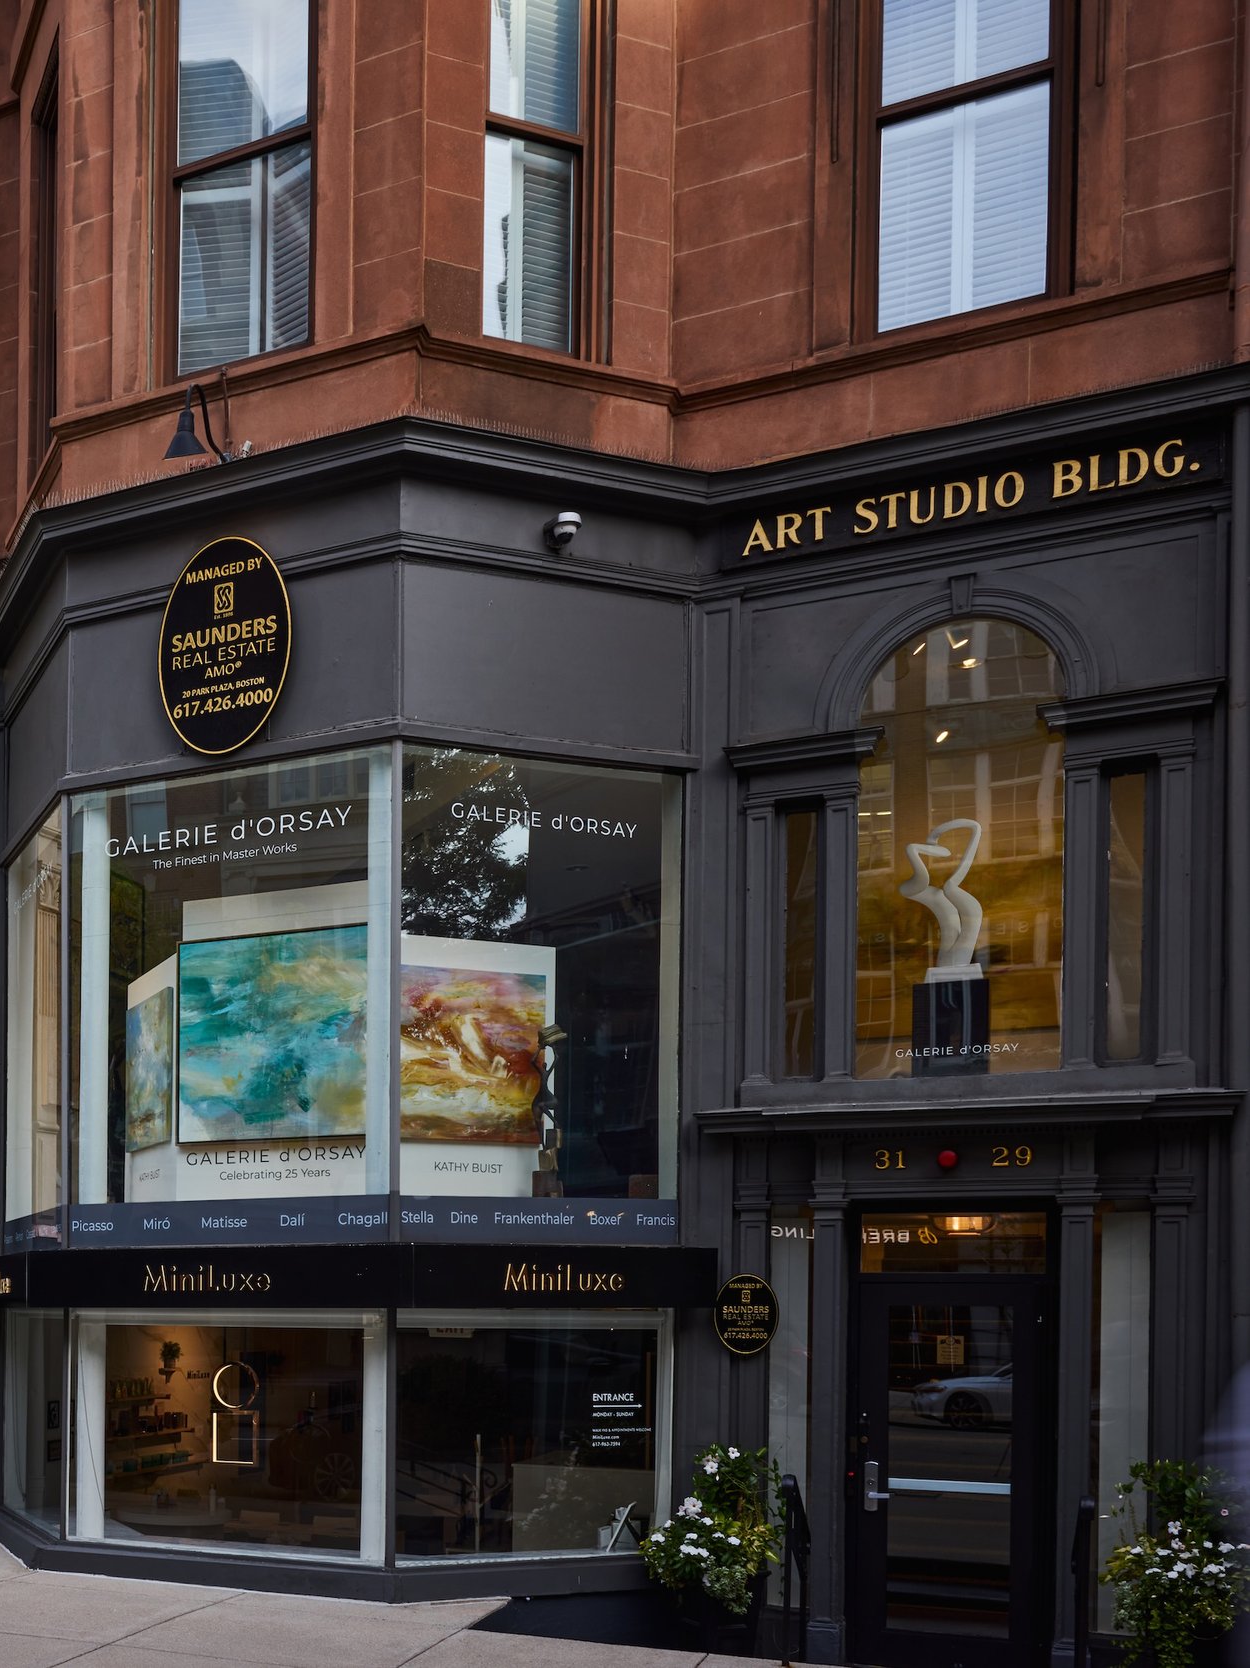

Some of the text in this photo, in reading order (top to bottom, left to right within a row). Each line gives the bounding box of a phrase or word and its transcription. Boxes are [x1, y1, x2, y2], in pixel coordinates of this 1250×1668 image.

[741, 438, 1200, 556] ART STUDIO BLDG.
[186, 557, 262, 584] MANAGED BY
[172, 615, 277, 653] SAUNDERS
[173, 637, 276, 671] REAL ESTATE
[182, 677, 265, 699] 20 PARK PLAZA, BOSTON
[173, 688, 273, 719] 617.426.4000
[451, 802, 638, 839] GALERIE d'ORSAY
[104, 805, 352, 858] GALERIE d'ORSAY
[153, 842, 297, 870] The Finest in Master Works
[896, 1043, 1019, 1058] GALERIE d'ORSAY
[186, 1145, 366, 1166] GALERIE d'ORSAY
[874, 1150, 906, 1170] 31
[991, 1146, 1032, 1167] 29
[219, 1168, 331, 1181] Celebrating 25 Years
[434, 1162, 503, 1174] KATHY BUIST
[72, 1220, 114, 1233] Picasso
[143, 1217, 171, 1230] Miró
[201, 1216, 248, 1229] Matisse
[280, 1213, 305, 1227] Dalí
[338, 1212, 388, 1227] Chagall
[401, 1211, 676, 1227] Stella Dine Frankenthaler Boxer Francis
[722, 1306, 770, 1314] SAUNDERS
[593, 1393, 634, 1402] ENTRANCE
